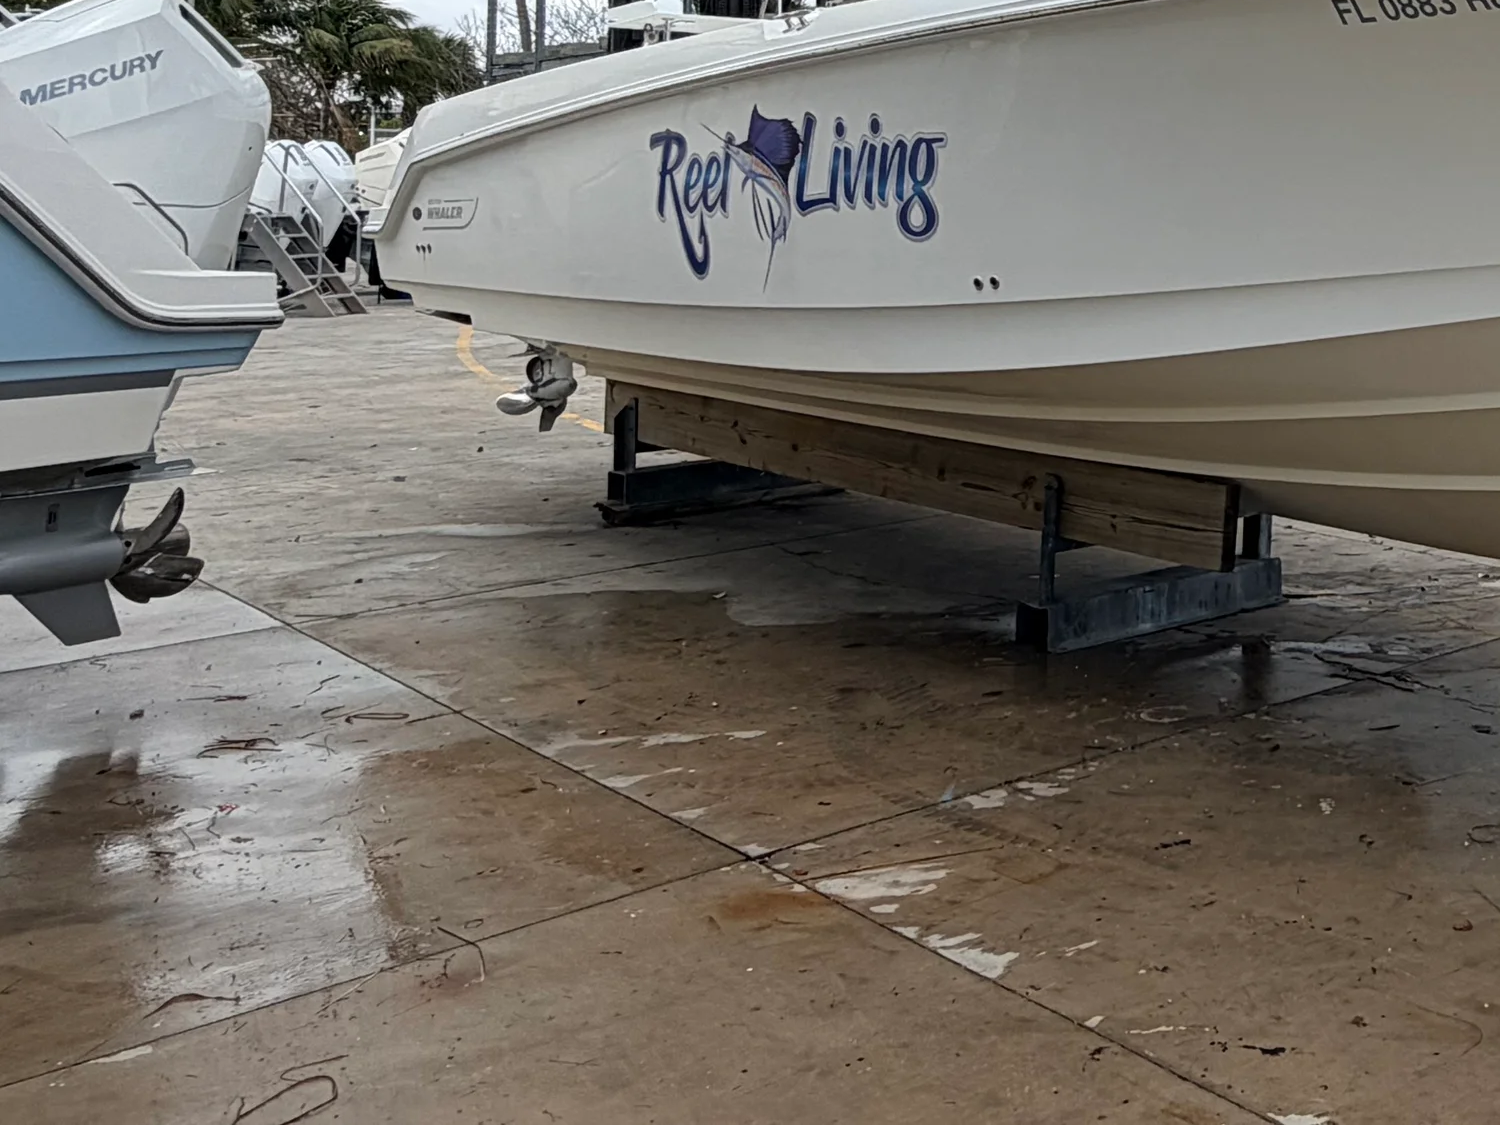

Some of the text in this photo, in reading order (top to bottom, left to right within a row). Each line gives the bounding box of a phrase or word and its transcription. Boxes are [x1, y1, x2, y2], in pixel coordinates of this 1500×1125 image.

[19, 49, 164, 106] MERCURY
[427, 205, 463, 220] WHALER
[649, 111, 948, 279] Reel Living
